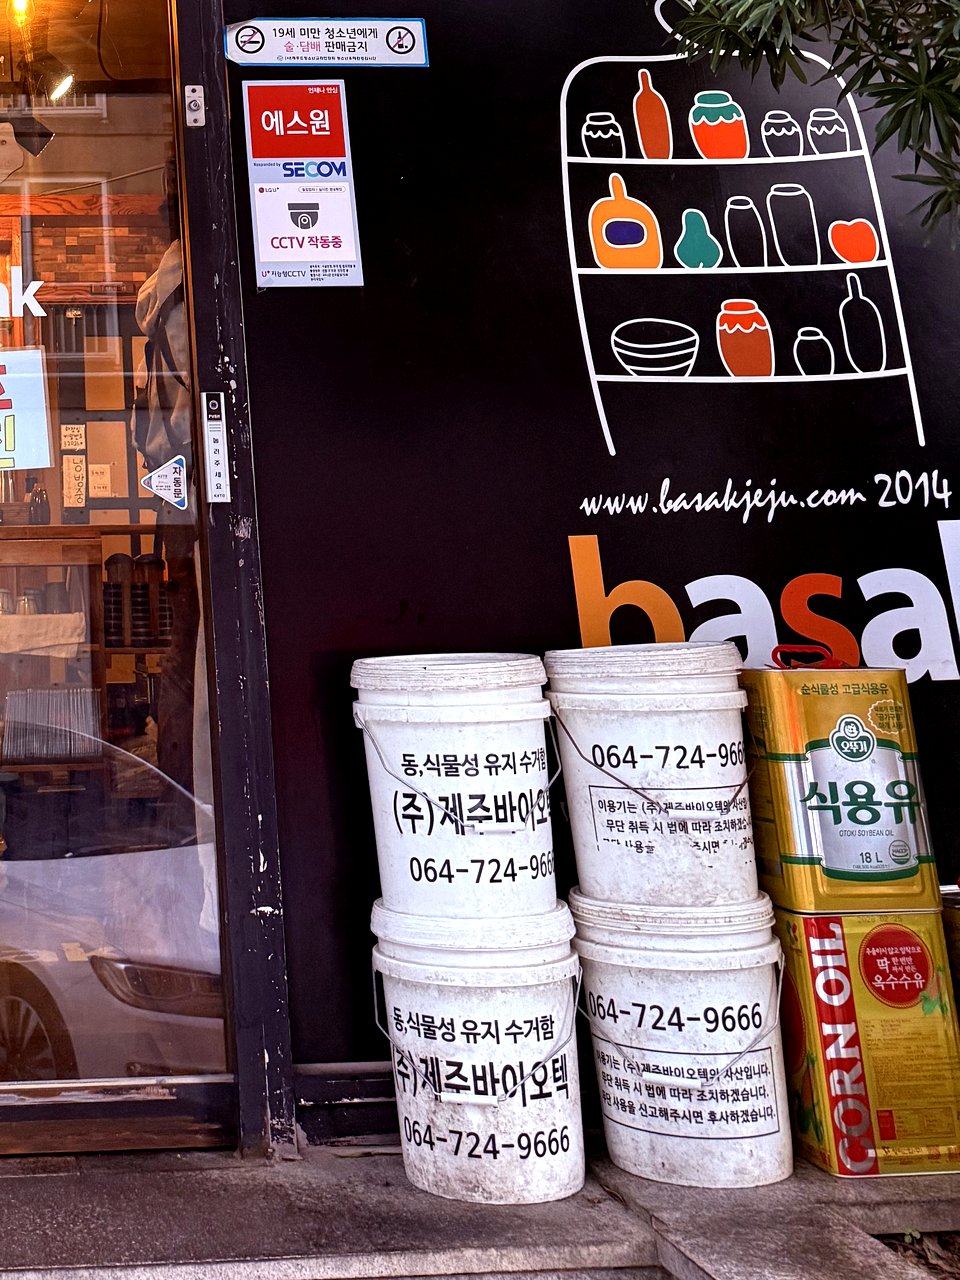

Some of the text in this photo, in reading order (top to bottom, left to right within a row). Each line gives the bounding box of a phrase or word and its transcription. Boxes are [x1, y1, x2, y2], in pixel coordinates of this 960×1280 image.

[272, 27, 378, 40] 19세 미만 청소년에게
[325, 41, 368, 53] 판매금지
[261, 109, 331, 136] 에스원
[282, 161, 347, 178] SECOM
[270, 235, 343, 249] CCTV 작동중
[172, 466, 182, 499] 자동문
[579, 469, 952, 523] www.basakjeju.com 2014
[800, 682, 889, 696] 순식물성 고급식용유
[591, 740, 745, 769] 064-724-966
[840, 740, 868, 753] 오뚜기
[401, 747, 546, 777] 동,식물성 유지 수거함
[597, 799, 638, 814] 이용기는
[799, 779, 920, 826] 식용유
[605, 818, 625, 833] 무단
[628, 819, 650, 834] 취득
[652, 820, 663, 835] 시
[667, 819, 688, 835] 법에
[691, 820, 712, 834] 따라
[857, 829, 884, 837] SOYBEAN
[884, 829, 895, 837] OIL
[409, 850, 556, 884] 064-724-966
[859, 851, 883, 864] 18 L
[876, 956, 891, 974] 딱
[871, 972, 926, 991] 옥수수유
[588, 990, 763, 1033] 064-724-9666
[393, 1006, 555, 1045] 동,식물성 유지 수거함
[809, 922, 876, 1174] CORN OIL
[633, 1081, 643, 1096] 시
[645, 1083, 667, 1100] 법에
[669, 1087, 693, 1103] 따라
[696, 1084, 769, 1104] 조치하겠습니다.
[612, 1093, 636, 1115] 사용을
[638, 1102, 704, 1124] 신고해주시면
[707, 1103, 777, 1124] 후사하겠습니다.
[404, 1115, 570, 1160] 064-724-9666
